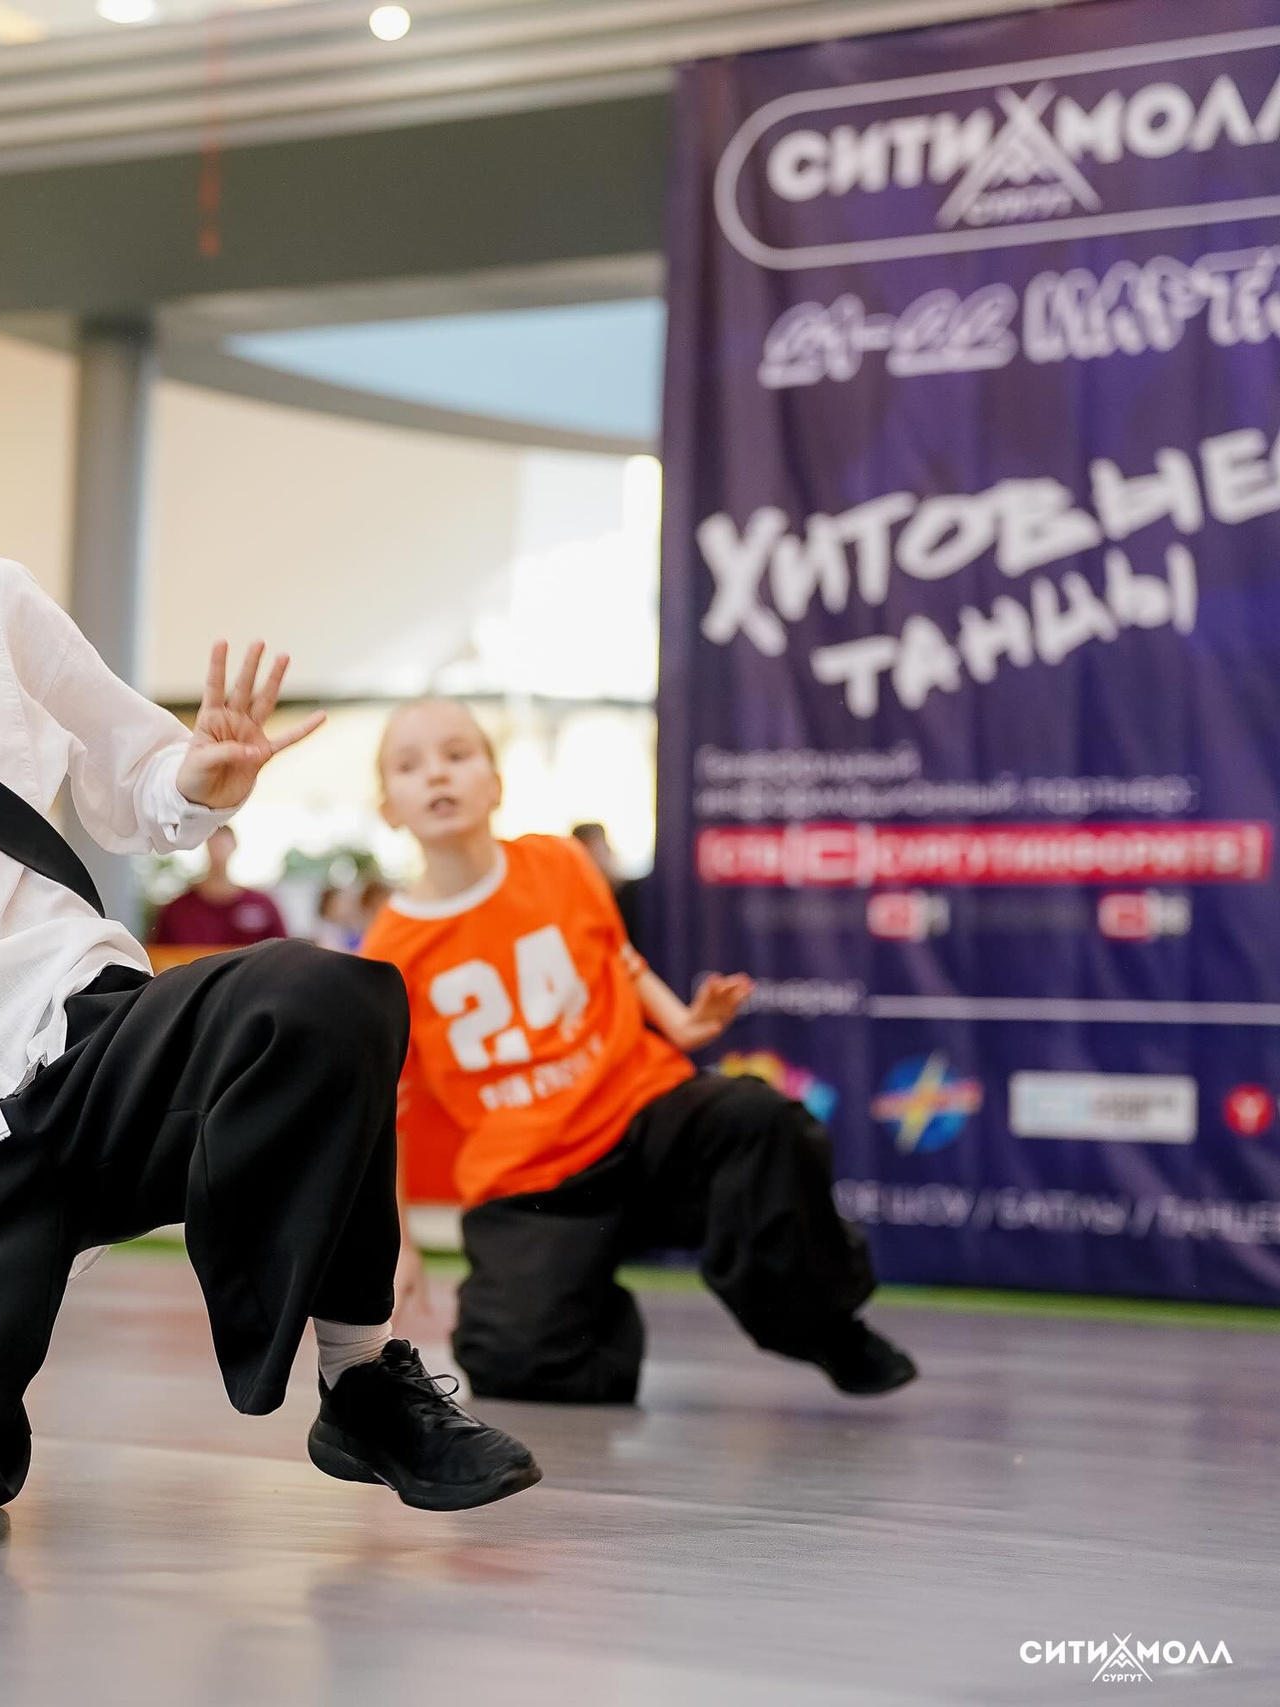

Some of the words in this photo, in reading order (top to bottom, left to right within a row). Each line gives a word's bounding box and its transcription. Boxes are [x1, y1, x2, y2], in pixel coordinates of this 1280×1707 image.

[766, 107, 994, 202] СИТИ
[1023, 243, 1280, 364] МАРТ
[810, 543, 1198, 718] ТАНЦЫ
[429, 924, 590, 1072] 24
